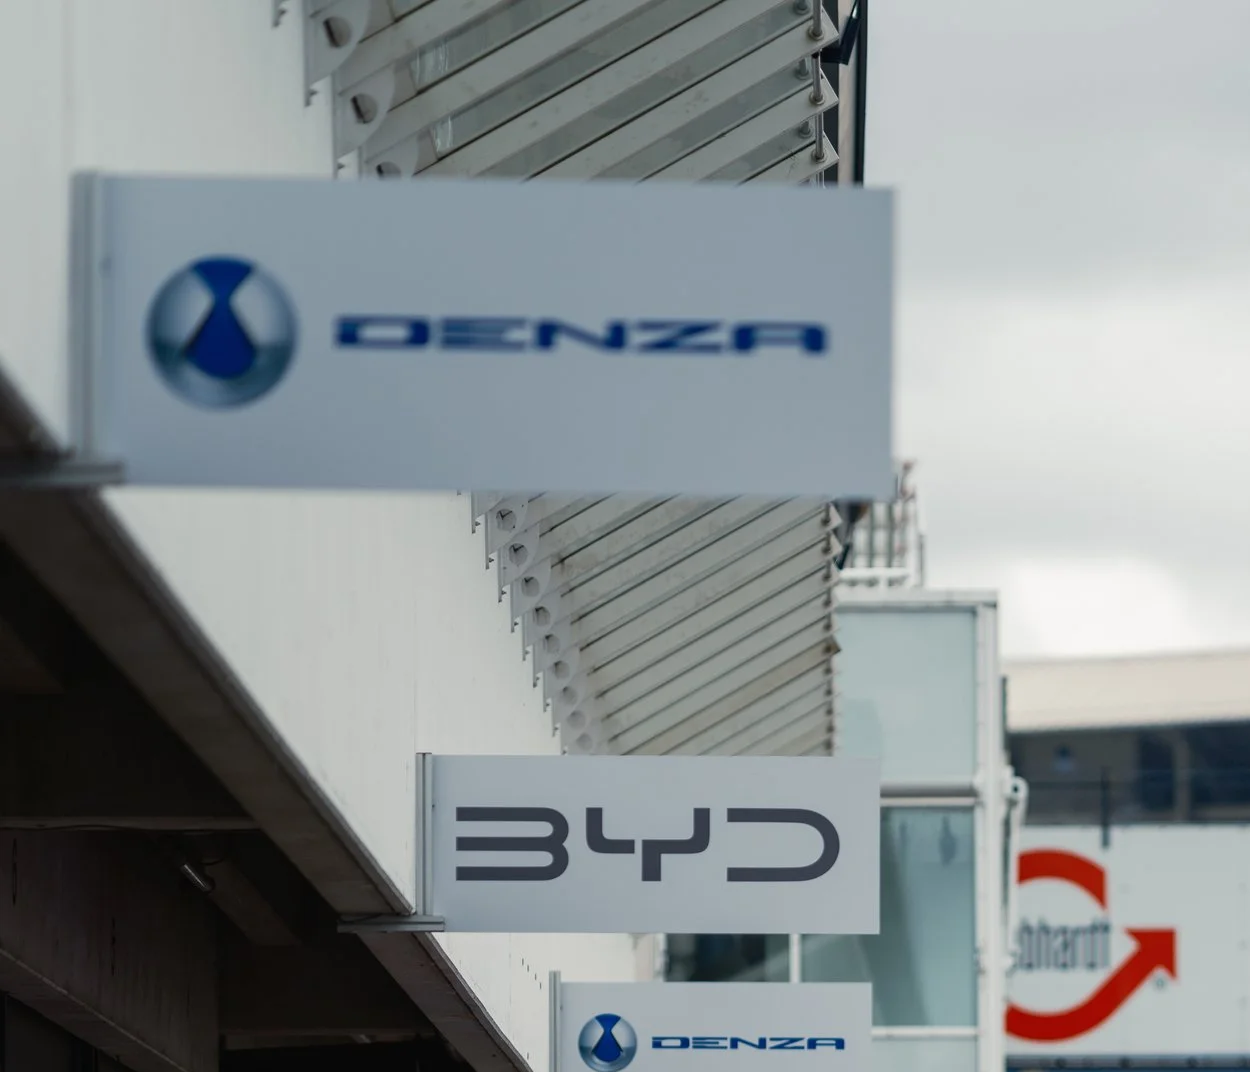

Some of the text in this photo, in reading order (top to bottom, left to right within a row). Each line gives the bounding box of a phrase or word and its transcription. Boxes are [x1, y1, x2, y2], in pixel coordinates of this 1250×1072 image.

[334, 314, 830, 356] DENZA
[456, 806, 841, 882] BYD
[652, 1036, 845, 1051] DENZA
